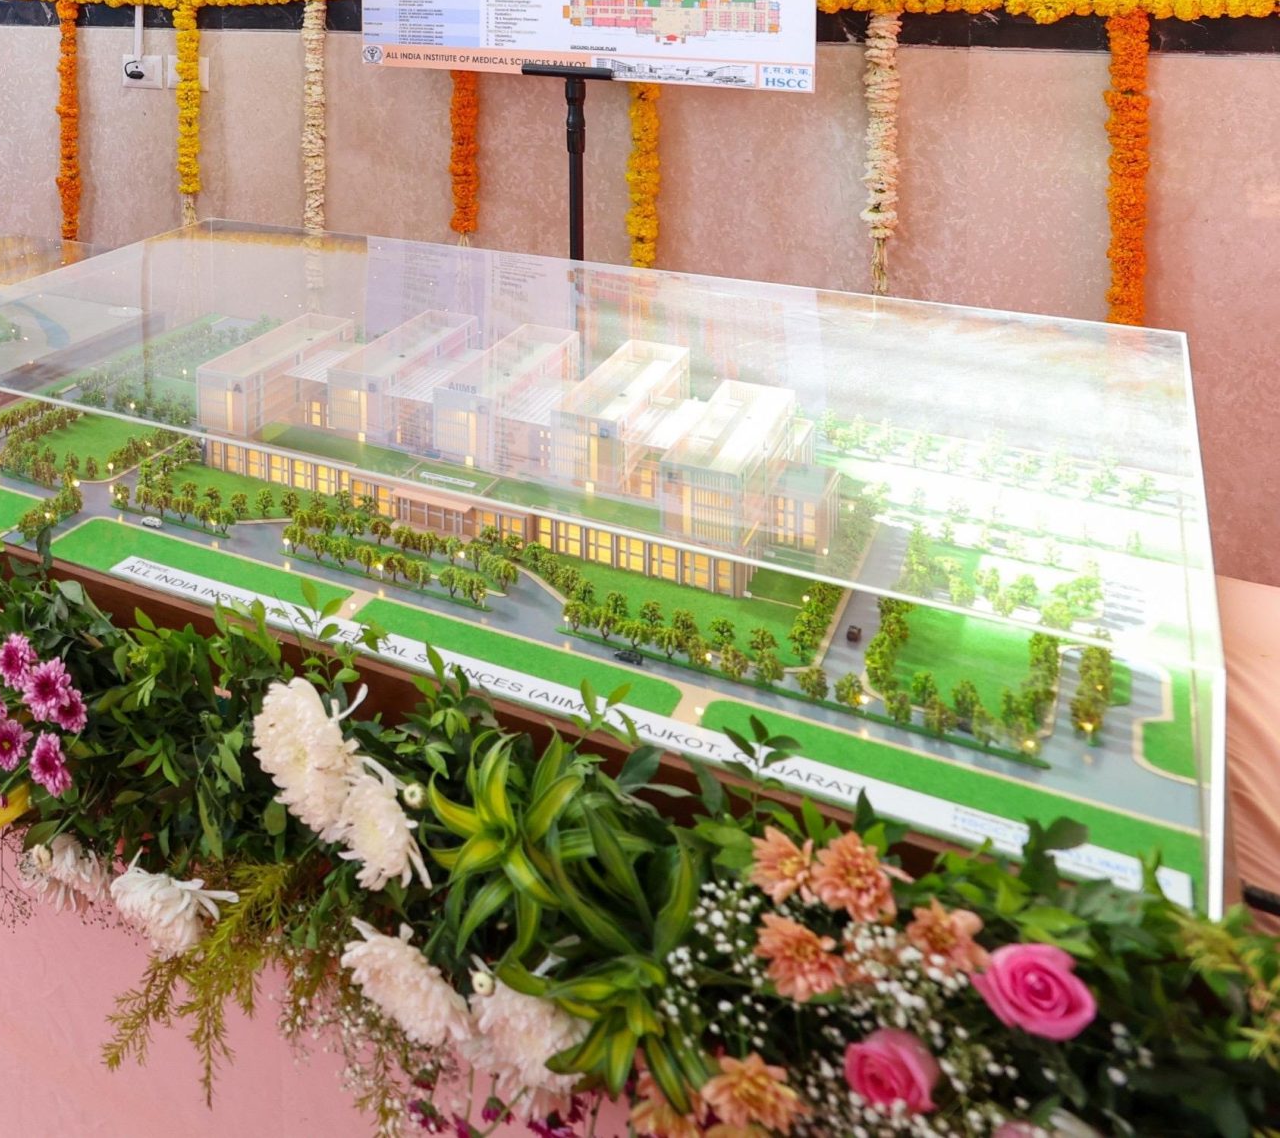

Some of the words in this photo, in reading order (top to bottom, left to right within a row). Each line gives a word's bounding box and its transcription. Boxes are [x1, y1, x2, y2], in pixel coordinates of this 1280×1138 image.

[385, 51, 398, 60] ALL
[400, 52, 421, 61] INDIA
[423, 53, 457, 63] INSTITUTE
[459, 55, 470, 64] OF
[472, 55, 508, 66] MEDICAL
[765, 77, 809, 89] HSCC
[123, 565, 150, 578] ALL
[154, 574, 199, 592] INDIA
